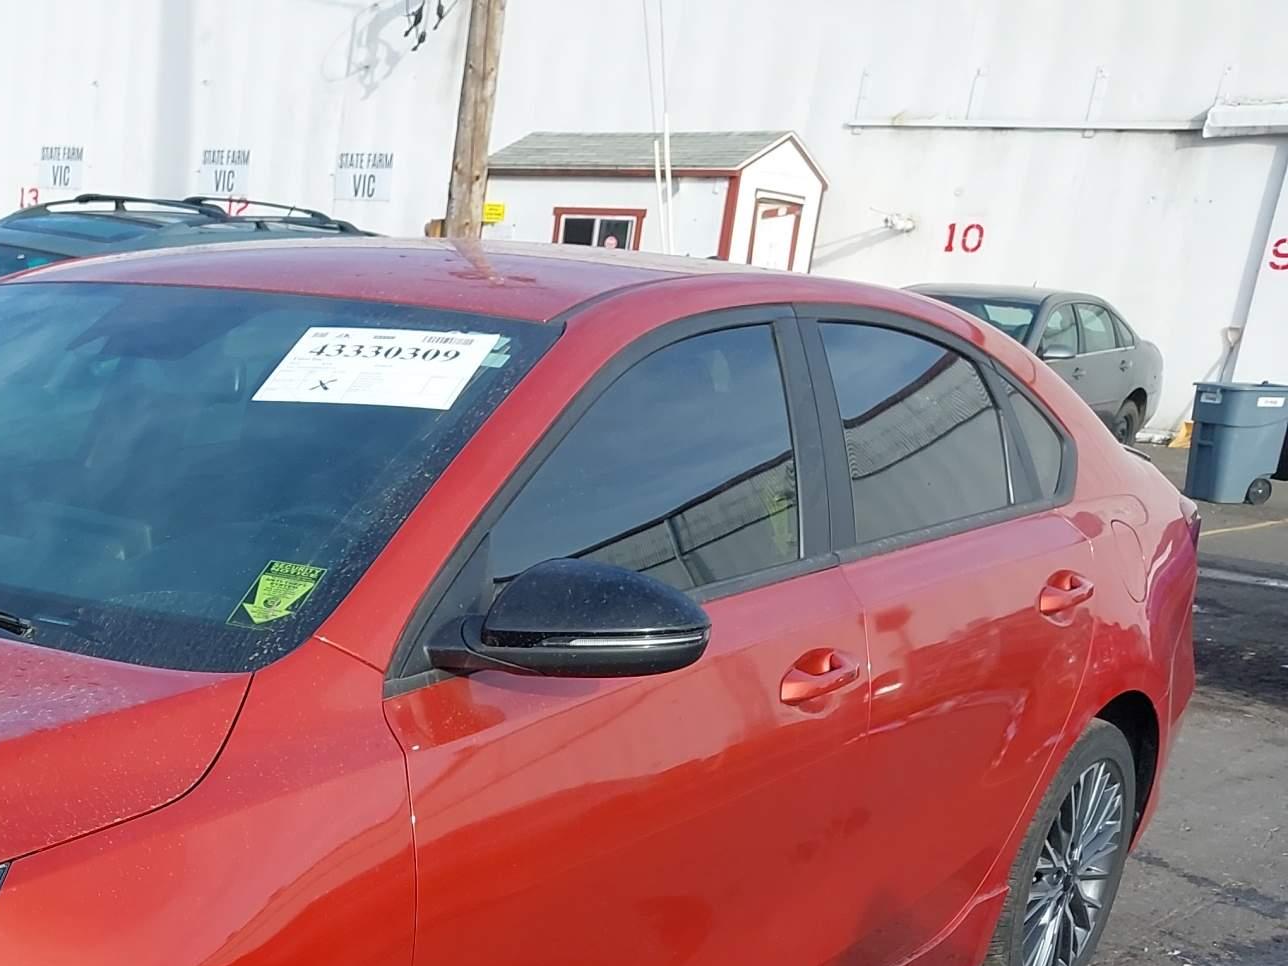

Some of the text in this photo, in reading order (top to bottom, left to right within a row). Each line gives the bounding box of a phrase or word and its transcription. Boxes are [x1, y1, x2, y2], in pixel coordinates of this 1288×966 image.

[41, 146, 84, 162] STATE FARM
[202, 149, 250, 166] STATE FARM
[338, 152, 394, 169] STATE FARM
[51, 165, 71, 187] VIC
[213, 170, 235, 193] VIC
[352, 173, 376, 198] VIC
[19, 187, 40, 208] 13
[944, 222, 985, 253] 10
[308, 343, 462, 362] 43330309
[272, 562, 322, 575] SECURITY
